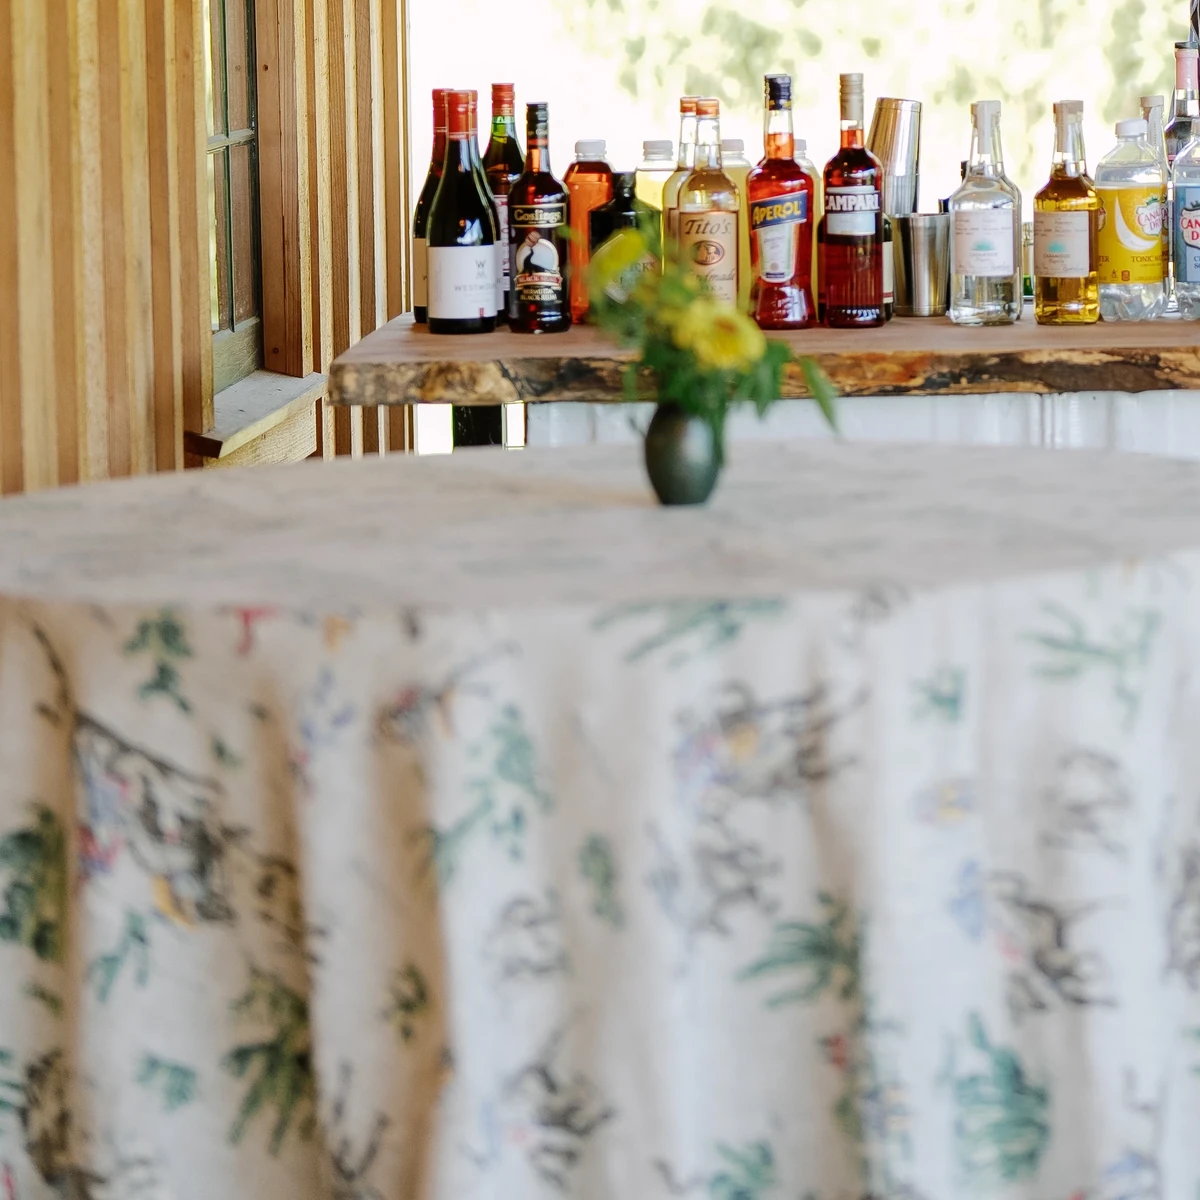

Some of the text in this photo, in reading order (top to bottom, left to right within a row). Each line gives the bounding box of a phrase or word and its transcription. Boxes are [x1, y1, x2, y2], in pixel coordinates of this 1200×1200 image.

[753, 201, 802, 225] APEROL
[685, 218, 732, 235] Tito's
[1131, 255, 1153, 263] TONIC
